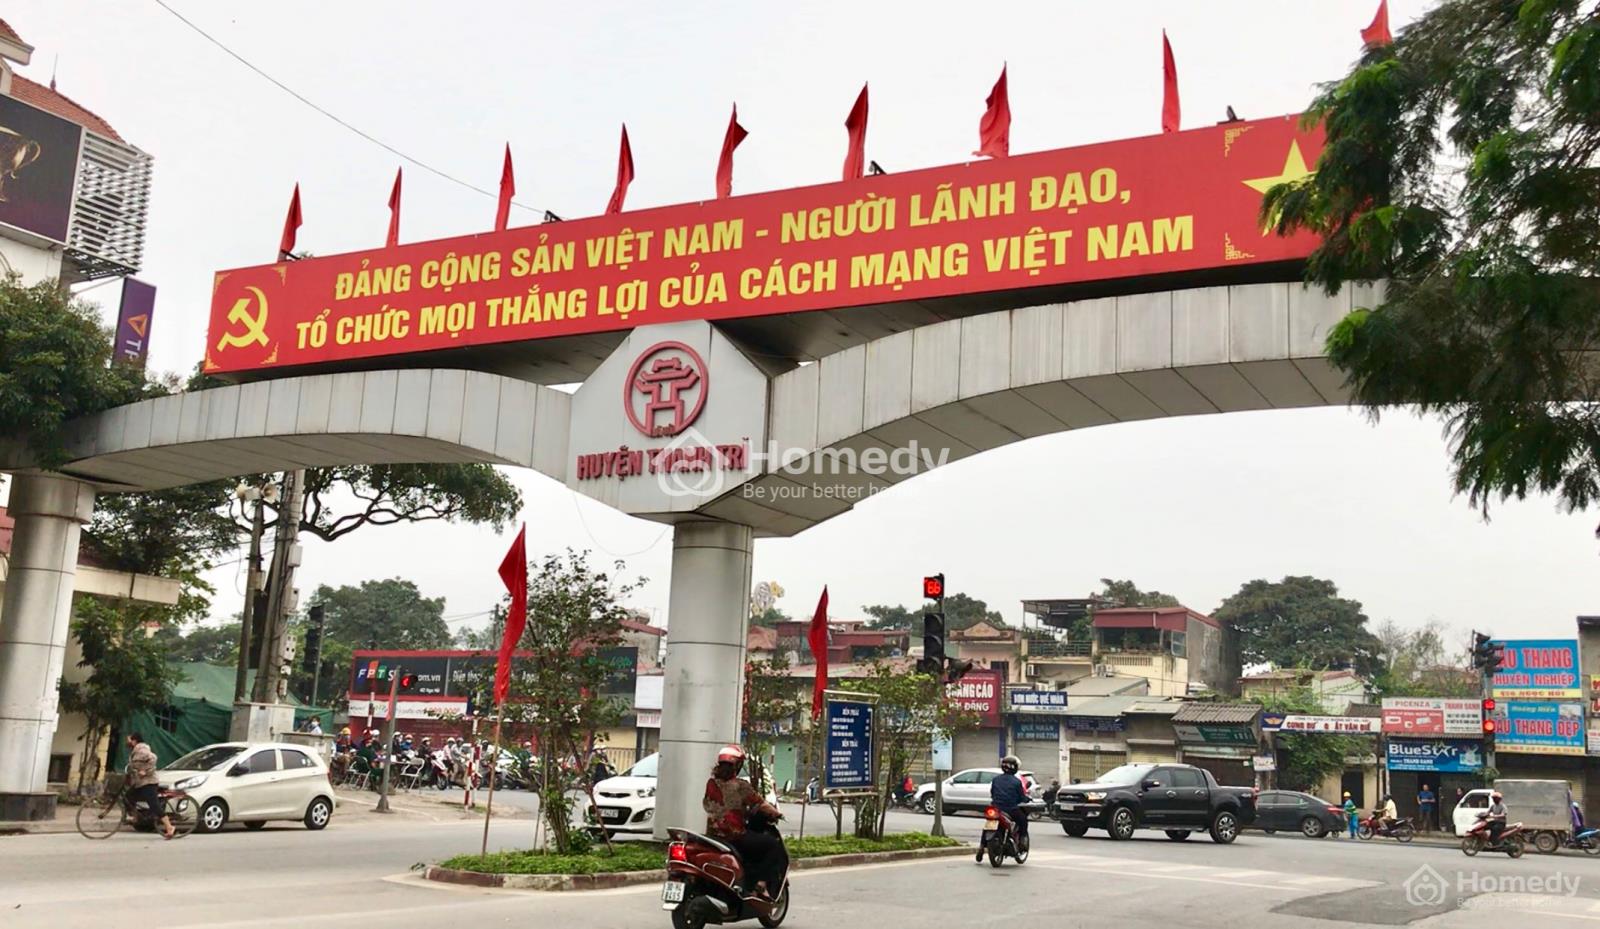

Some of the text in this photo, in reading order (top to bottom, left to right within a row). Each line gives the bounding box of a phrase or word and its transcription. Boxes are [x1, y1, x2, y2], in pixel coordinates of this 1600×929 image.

[335, 258, 411, 301] ĐẢNG
[420, 251, 501, 290] CỘNG
[511, 233, 574, 279] SẢN
[585, 227, 655, 270] VIỆT
[663, 218, 744, 258] NAM
[780, 196, 895, 244] NGƯỜI
[909, 183, 1016, 228] LÃNH
[1028, 167, 1131, 214] ĐẠO,
[295, 215, 1195, 350] TỔ CHỨC MỌI THẮNG LỢI CỦA CÁCH MẠNG VIỆT NAM
[577, 445, 643, 481] HUYỆN
[1522, 648, 1572, 668] THANG
[1493, 672, 1530, 686] HUYÊN
[976, 681, 993, 698] CÁO
[1395, 700, 1430, 708] PICENZA
[1515, 719, 1553, 736] THANG
[1557, 720, 1579, 739] ĐẸP
